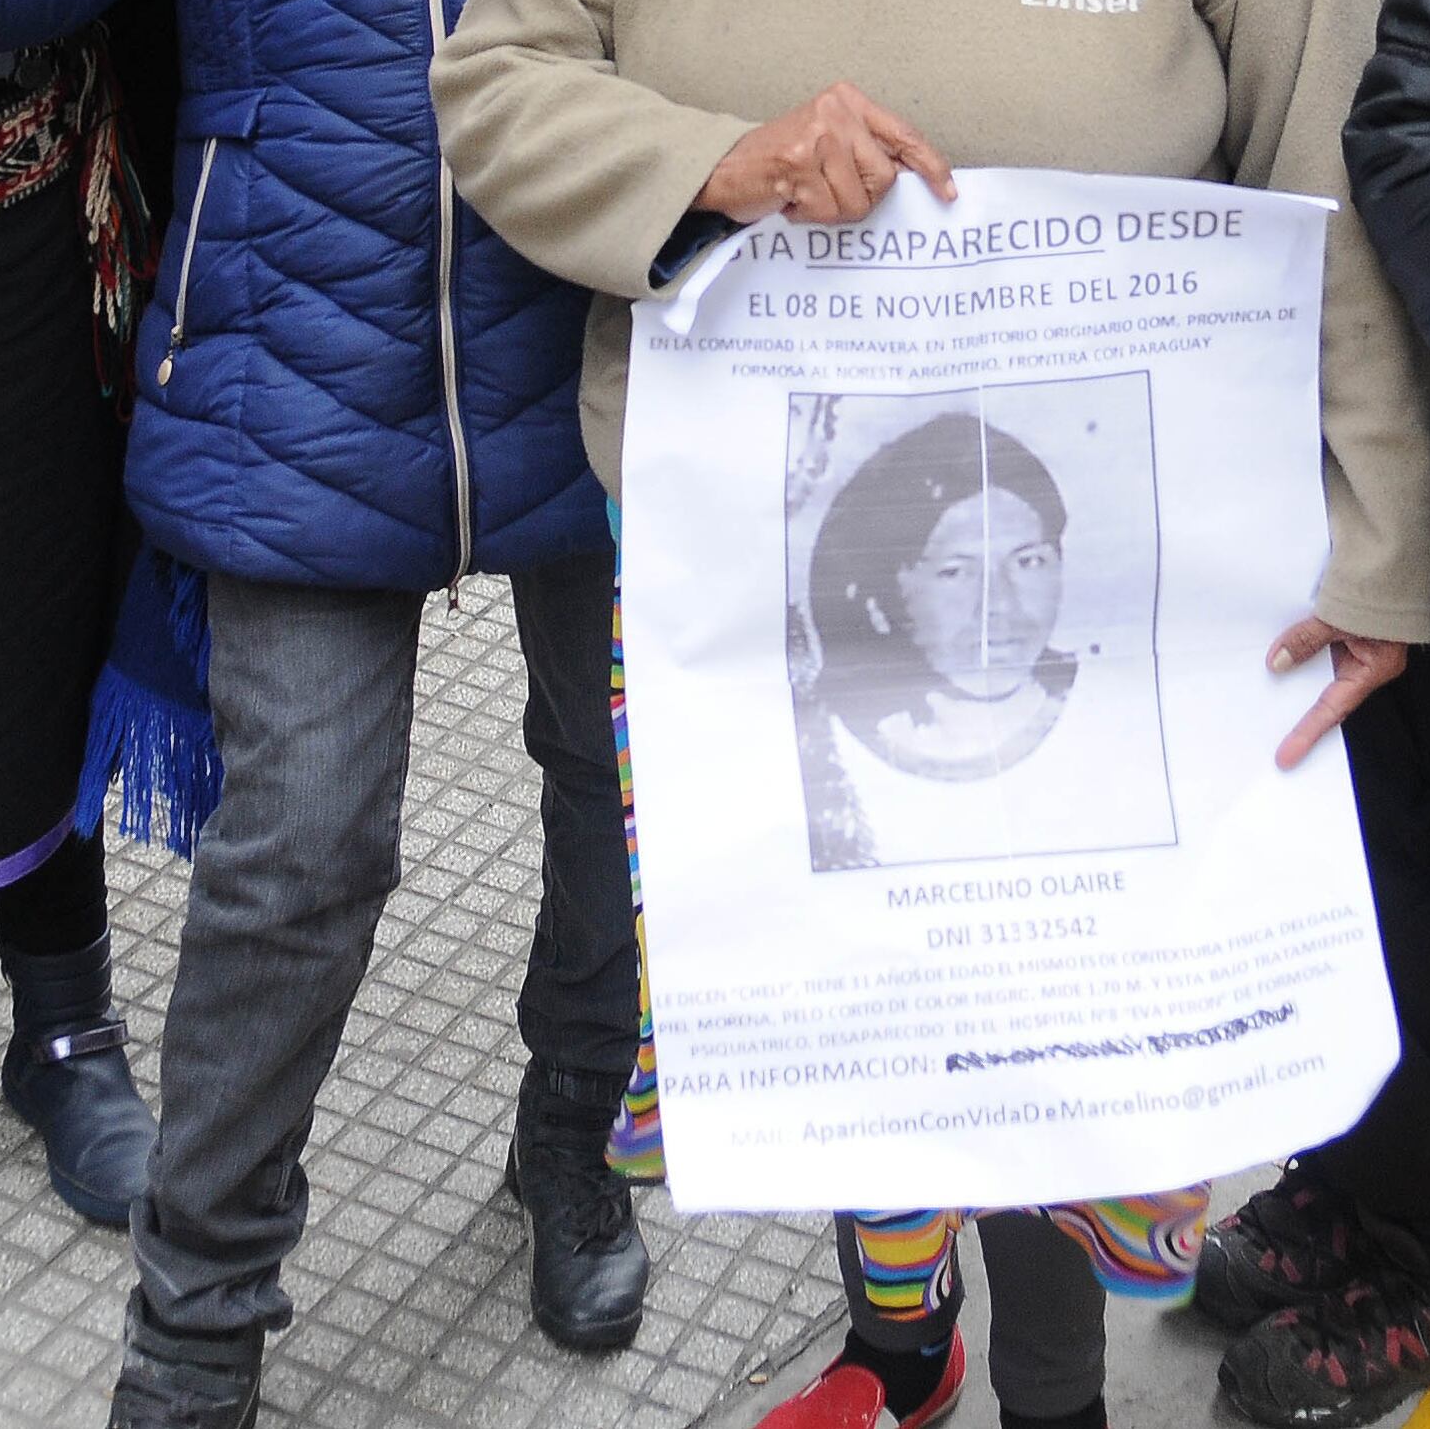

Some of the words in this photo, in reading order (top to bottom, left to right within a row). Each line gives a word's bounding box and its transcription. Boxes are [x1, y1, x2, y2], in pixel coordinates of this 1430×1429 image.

[808, 212, 1104, 261] DESAPARECIDO
[1117, 208, 1244, 243] DESDE
[748, 292, 778, 319] EL
[785, 292, 818, 319] 08
[829, 293, 863, 320] DE
[875, 281, 1054, 321] NOVIEMBRE
[1068, 273, 1118, 304] DEL
[1128, 270, 1199, 299] 2016
[673, 336, 693, 352] LA
[698, 336, 795, 353] COMUNIDAD
[825, 337, 918, 354] PRIMAVERA
[926, 339, 945, 353] EN
[1043, 320, 1133, 342] ORIGINARIO
[1186, 308, 1272, 328] PROVINCIA
[1277, 306, 1298, 321] DE
[731, 363, 805, 379] FORMOSA
[1008, 350, 1089, 370] FRONTERA
[1094, 346, 1124, 363] CON
[1129, 336, 1213, 358] PARAGUAY
[886, 876, 1033, 909] MARCELINO
[1040, 869, 1127, 898] OLAIRE
[926, 924, 972, 950] DNI
[658, 1019, 690, 1036] PIEL
[782, 1007, 824, 1026] PELO
[828, 999, 883, 1021] CORTO
[888, 997, 908, 1014] DE
[914, 991, 969, 1012] COLOR
[1254, 927, 1365, 970] TRATAMIENTO
[677, 988, 727, 1008] DICEN
[818, 1021, 945, 1049] DESAPARECIDO
[663, 1075, 731, 1098] PARA
[740, 1054, 939, 1092] INFORMACION:
[802, 1052, 1327, 1147] AparicionConVidaDeMarcelino@gmail.com
